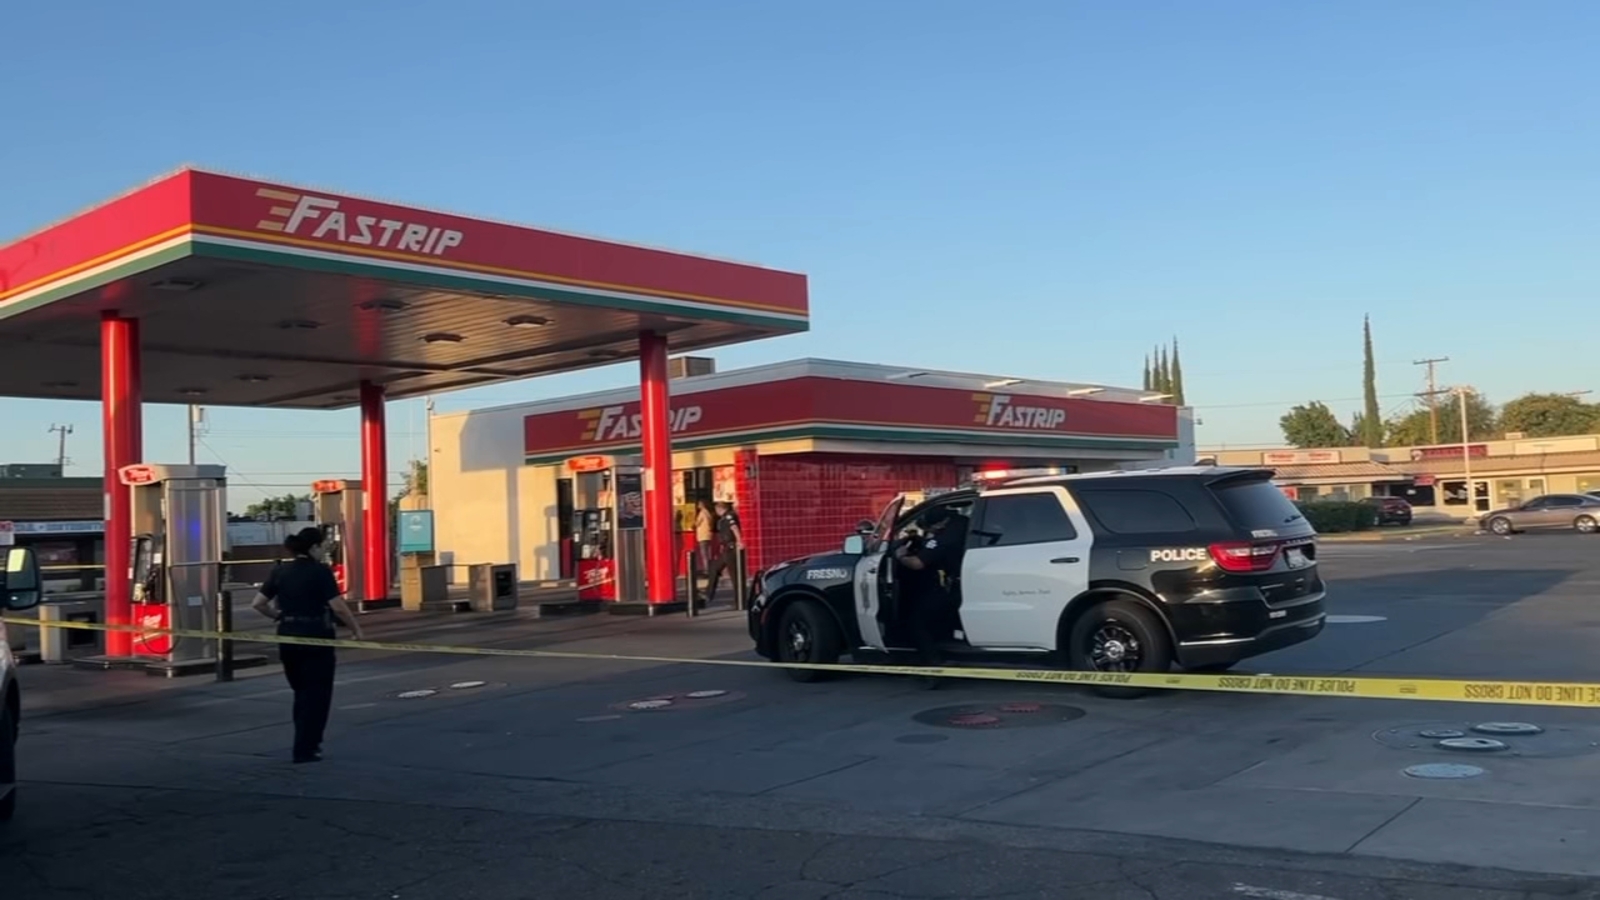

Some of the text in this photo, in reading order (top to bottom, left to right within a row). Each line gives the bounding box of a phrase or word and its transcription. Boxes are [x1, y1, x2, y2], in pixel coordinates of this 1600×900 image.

[283, 195, 463, 255] FASTRIP
[986, 395, 1066, 428] FASTRIP
[1151, 548, 1207, 562] POLICE
[806, 569, 847, 583] FRESNO
[1217, 677, 1356, 692] POLICE LINE DO NOT CROSS
[1464, 684, 1504, 699] CROSS
[1506, 685, 1532, 700] NOT
[1535, 686, 1552, 700] DO
[1555, 686, 1583, 701] LINE
